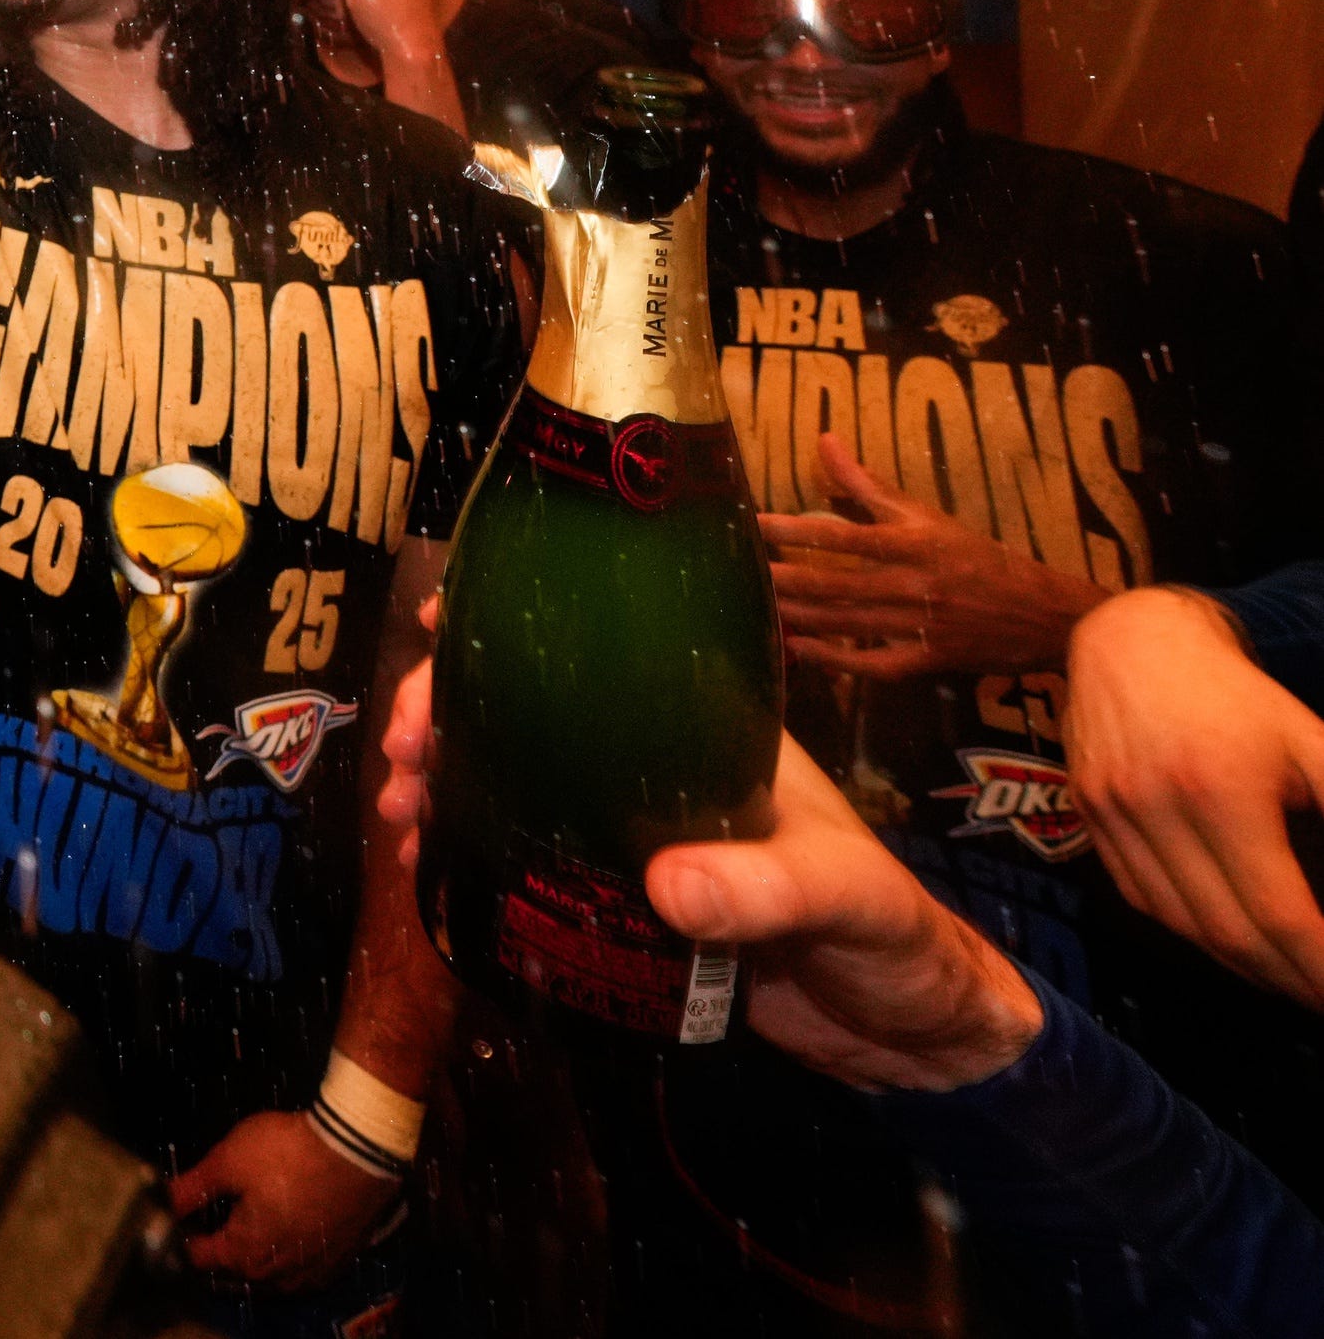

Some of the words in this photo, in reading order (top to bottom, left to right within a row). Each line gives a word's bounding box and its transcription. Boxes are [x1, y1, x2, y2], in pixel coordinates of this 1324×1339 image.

[92, 186, 235, 277] NBA
[642, 274, 668, 358] MARIE
[736, 287, 867, 351] NBA
[263, 568, 346, 675] 25
